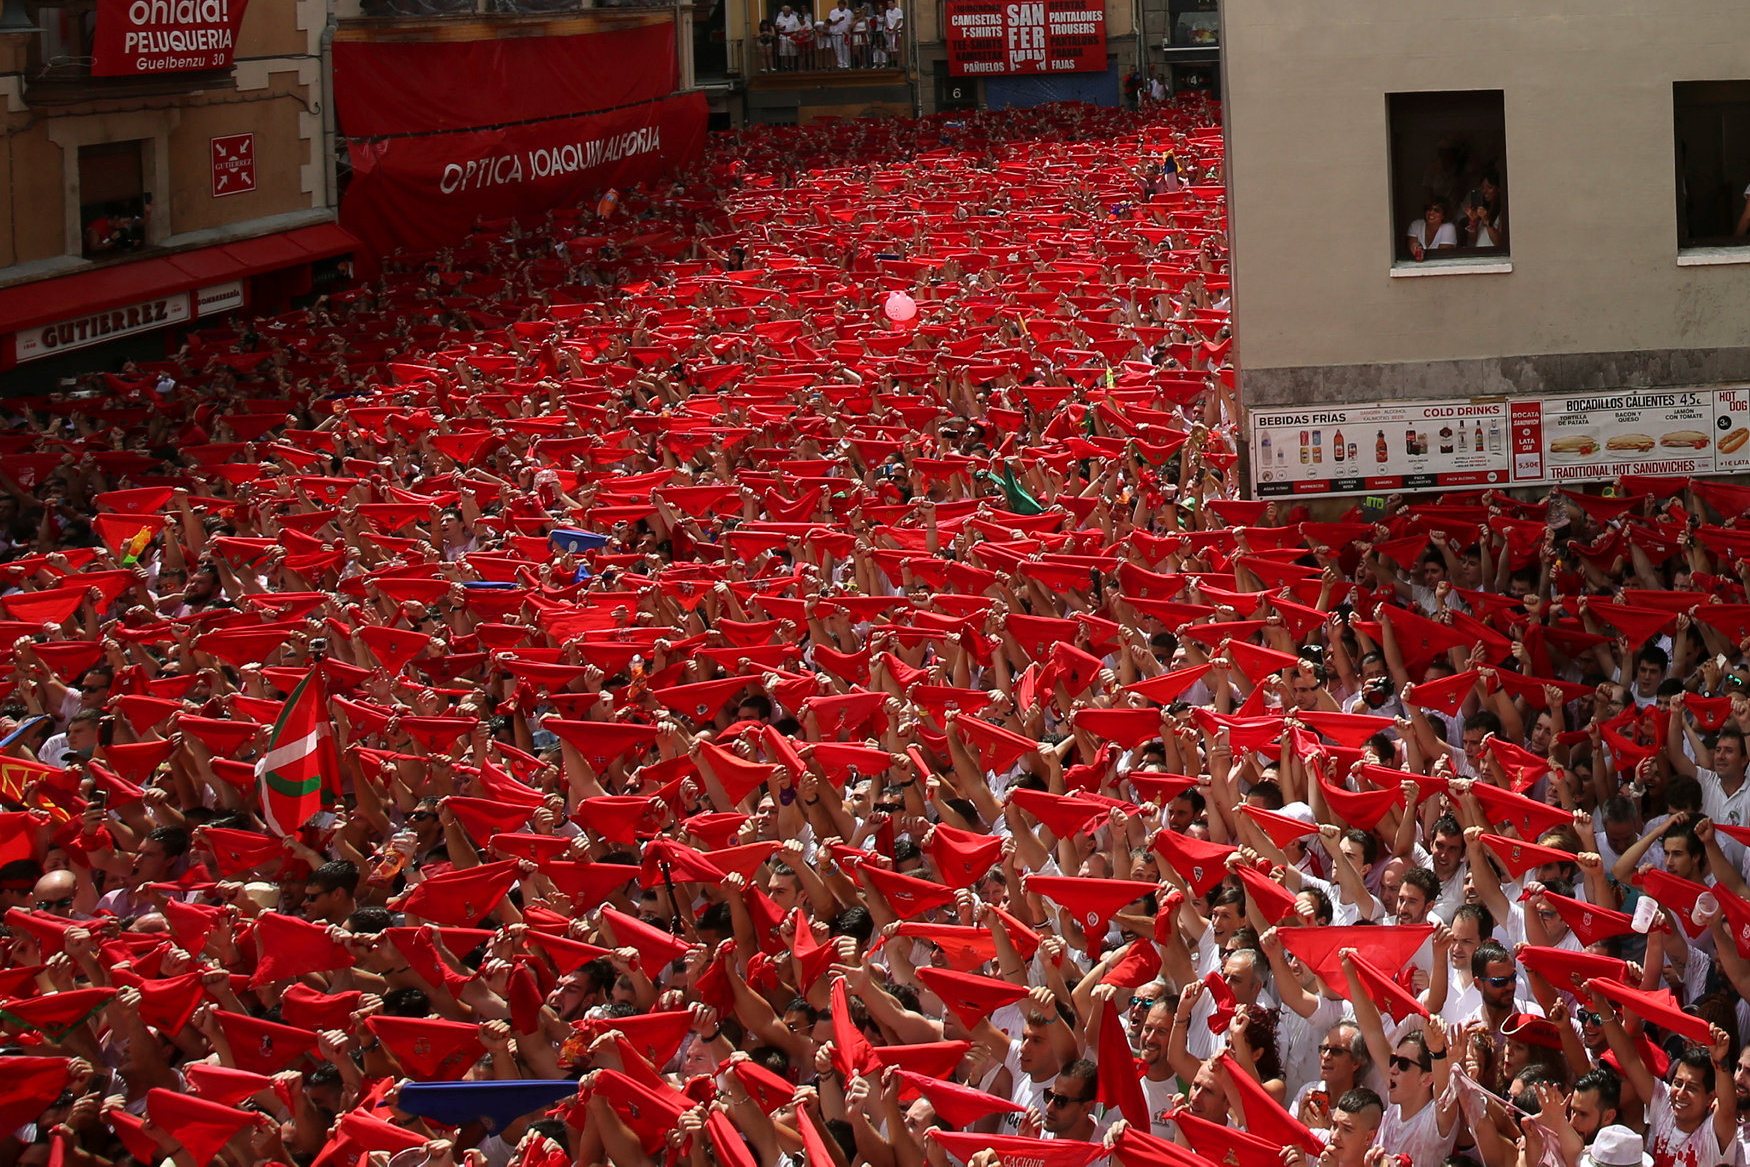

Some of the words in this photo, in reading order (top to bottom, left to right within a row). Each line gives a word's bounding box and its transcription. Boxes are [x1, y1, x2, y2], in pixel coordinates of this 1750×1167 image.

[951, 13, 1003, 26] CAMISETAS
[1006, 3, 1045, 27] SAN
[1049, 10, 1104, 23] PANTALONES
[961, 26, 1004, 38] T-SHIRTS
[1050, 23, 1096, 35] TROUSERS
[124, 29, 233, 54] PELUQUERIA
[1008, 26, 1045, 49] FER
[136, 56, 207, 71] Guelbenzu
[212, 53, 226, 67] 30
[963, 61, 1006, 73] PAÑUELOS
[1051, 59, 1076, 70] FAJAS
[1190, 75, 1198, 86] 4
[952, 87, 962, 99] 6
[215, 158, 253, 171] GUTIERREZ
[439, 154, 523, 194] OPTICA
[528, 139, 603, 181] JOAQUIN
[601, 125, 661, 167] ALFORJA
[41, 300, 169, 349] GUTIERREZ
[1566, 397, 1623, 412] BOCADILLOS
[1626, 394, 1675, 410] CALIENTES
[1719, 391, 1737, 402] HOT
[1424, 408, 1454, 418] COLD
[1457, 405, 1500, 416] DRINKS
[1729, 400, 1748, 411] DOG
[1259, 415, 1309, 426] BEBIDAS
[1313, 412, 1346, 423] FRÍAS
[1512, 411, 1540, 419] BOCATA
[1518, 461, 1538, 470] 5,50€
[1551, 465, 1610, 478] TRADITIONAL
[1613, 463, 1631, 475] HOT
[1633, 460, 1696, 475] SANDWICHES
[1003, 1154, 1045, 1167] CACIQUE
